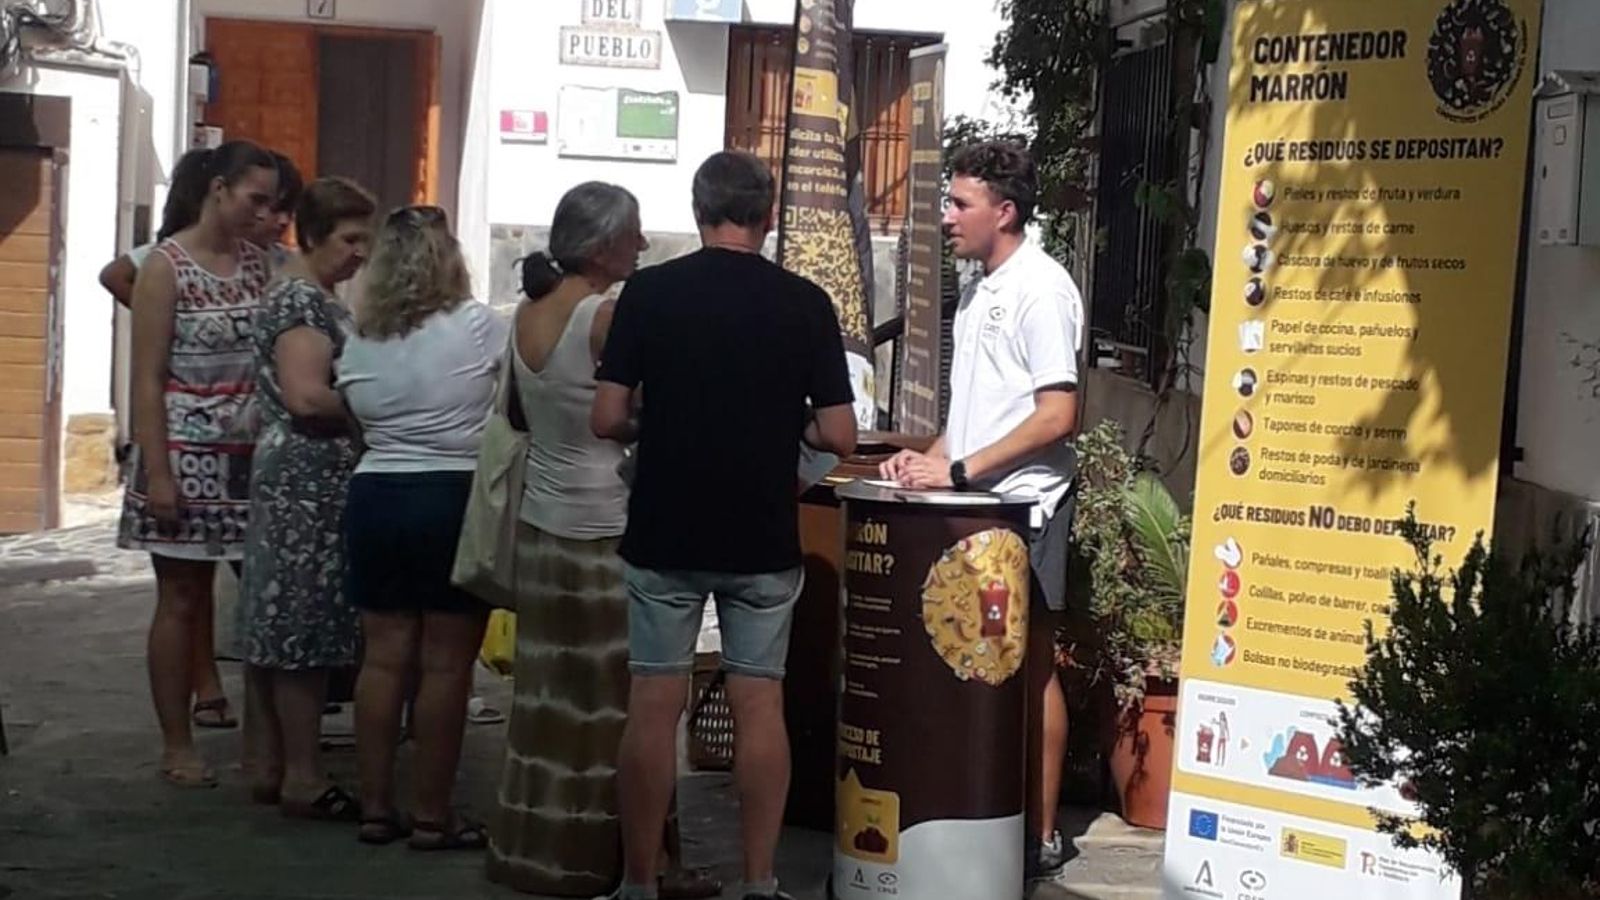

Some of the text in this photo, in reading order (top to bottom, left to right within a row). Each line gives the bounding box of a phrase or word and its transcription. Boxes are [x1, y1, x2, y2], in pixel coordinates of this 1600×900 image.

[591, 0, 632, 20] DEL
[569, 34, 652, 60] PUEBLO
[1254, 29, 1408, 66] CONTENEDOR
[1250, 65, 1348, 103] MARRÓN
[1244, 136, 1504, 167] ¿QUÉ RESIDUOS SE DEPOSITAN?
[1284, 187, 1461, 203] Pieles y restos de fruta y verdura
[1321, 224, 1329, 237] y
[1330, 221, 1363, 234] restos
[1365, 221, 1381, 234] de
[1383, 223, 1415, 234] carne
[1371, 258, 1378, 270] y
[1379, 256, 1394, 269] de
[1396, 256, 1430, 269] frutos
[1431, 258, 1465, 270] secos
[1273, 286, 1312, 301] Restos
[1315, 288, 1327, 301] de
[1362, 287, 1421, 303] infusiones
[1270, 319, 1301, 335] Papel
[1303, 321, 1318, 334] de
[1359, 324, 1411, 339] pañuelos
[1412, 327, 1419, 341] y
[1269, 341, 1361, 356] servilletas sucios
[1266, 369, 1420, 392] Espinas y restos de pescado
[1265, 391, 1316, 405] y marisco
[1263, 416, 1307, 434] Tapones
[1309, 420, 1322, 433] de
[1324, 422, 1363, 437] corcho
[1364, 426, 1372, 440] y
[1260, 447, 1297, 463] Restos
[1299, 451, 1311, 464] de
[1313, 451, 1341, 468] poda
[1342, 455, 1350, 469] y
[1350, 454, 1365, 468] de
[1258, 468, 1326, 486] domiciliarios
[1213, 502, 1244, 523] ¿QUÉ
[1246, 506, 1305, 527] RESIDUOS
[1308, 504, 1335, 530] NO
[1336, 515, 1371, 534] DEBO
[1251, 552, 1291, 570] Pañales,
[1294, 558, 1352, 577] compresas
[1354, 566, 1361, 580] y
[1248, 584, 1286, 602] Colillas,
[1288, 590, 1318, 608] polvo
[1318, 592, 1333, 606] de
[1333, 594, 1369, 613] barrer,
[1246, 616, 1312, 638] Excrementos
[1314, 623, 1327, 639] de
[1242, 649, 1276, 665] Bolsas
[1278, 655, 1291, 669] no
[866, 729, 881, 746] DE
